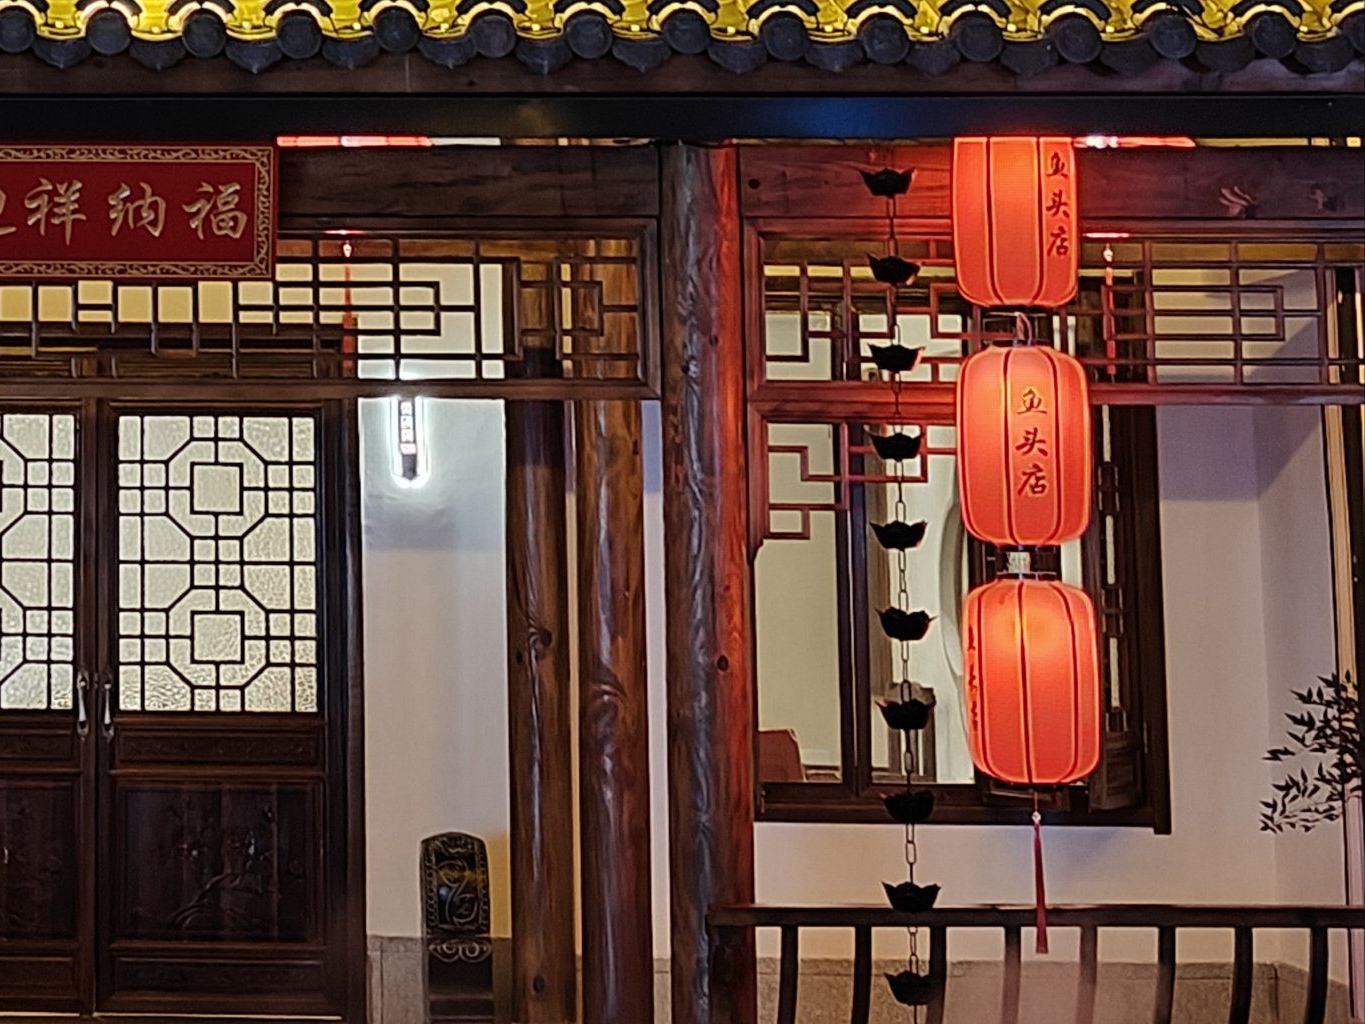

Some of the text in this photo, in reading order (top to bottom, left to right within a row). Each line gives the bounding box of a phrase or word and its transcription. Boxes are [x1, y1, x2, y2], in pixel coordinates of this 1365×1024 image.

[1045, 151, 1070, 257] 鱼头店
[1015, 387, 1049, 496] 鱼头店
